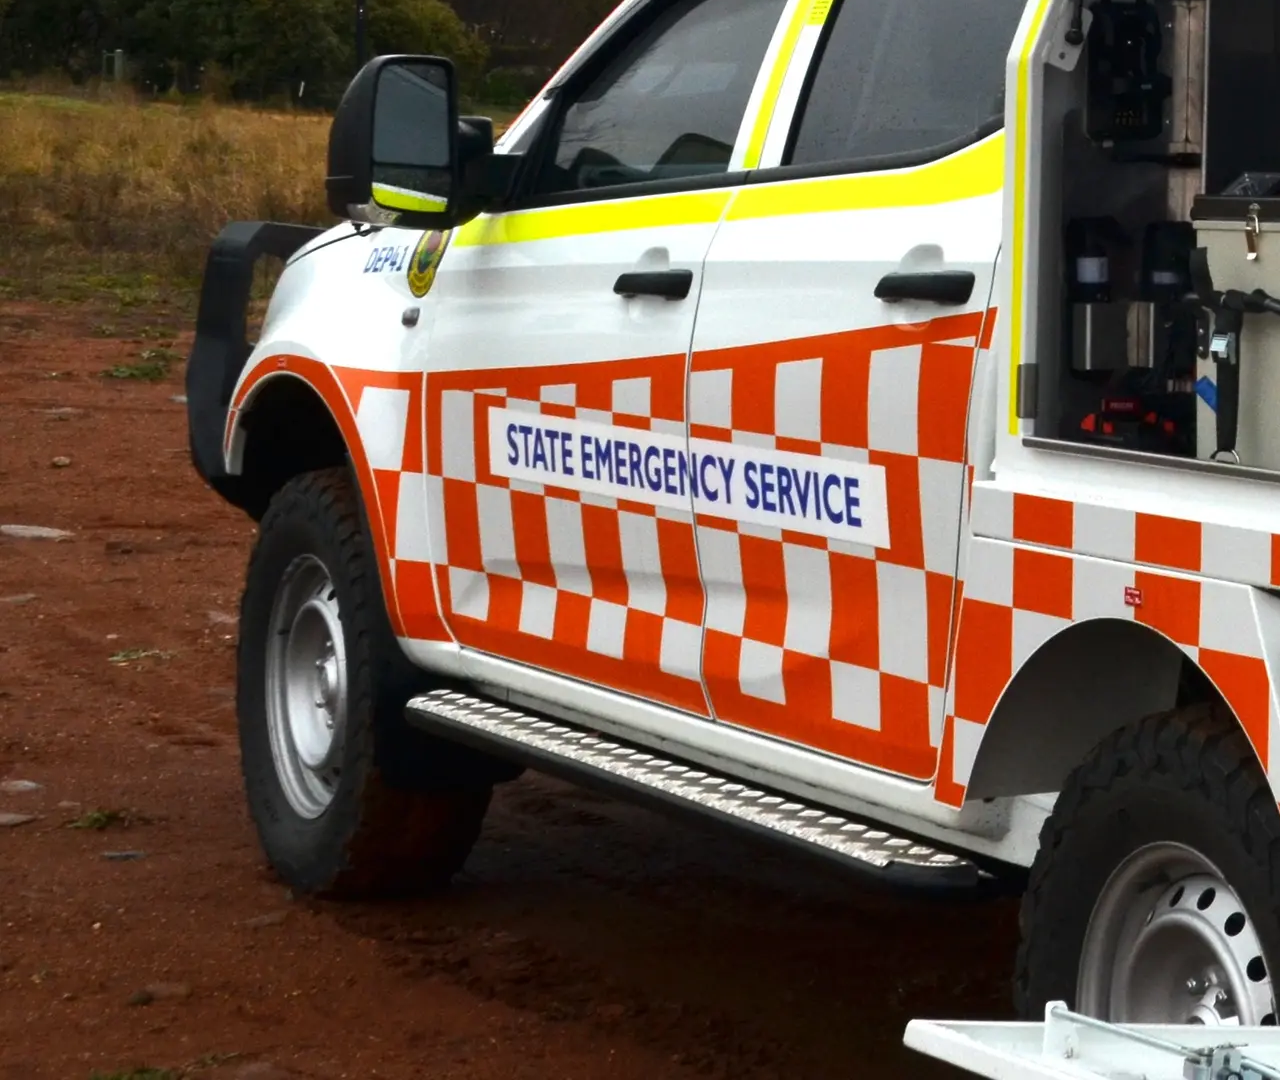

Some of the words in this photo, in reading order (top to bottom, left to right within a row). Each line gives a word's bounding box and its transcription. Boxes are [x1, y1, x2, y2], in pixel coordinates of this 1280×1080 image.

[364, 245, 409, 273] DEP41
[507, 423, 574, 476] STATE
[580, 435, 735, 504] EMERGENCY
[745, 461, 862, 527] SERVICE
